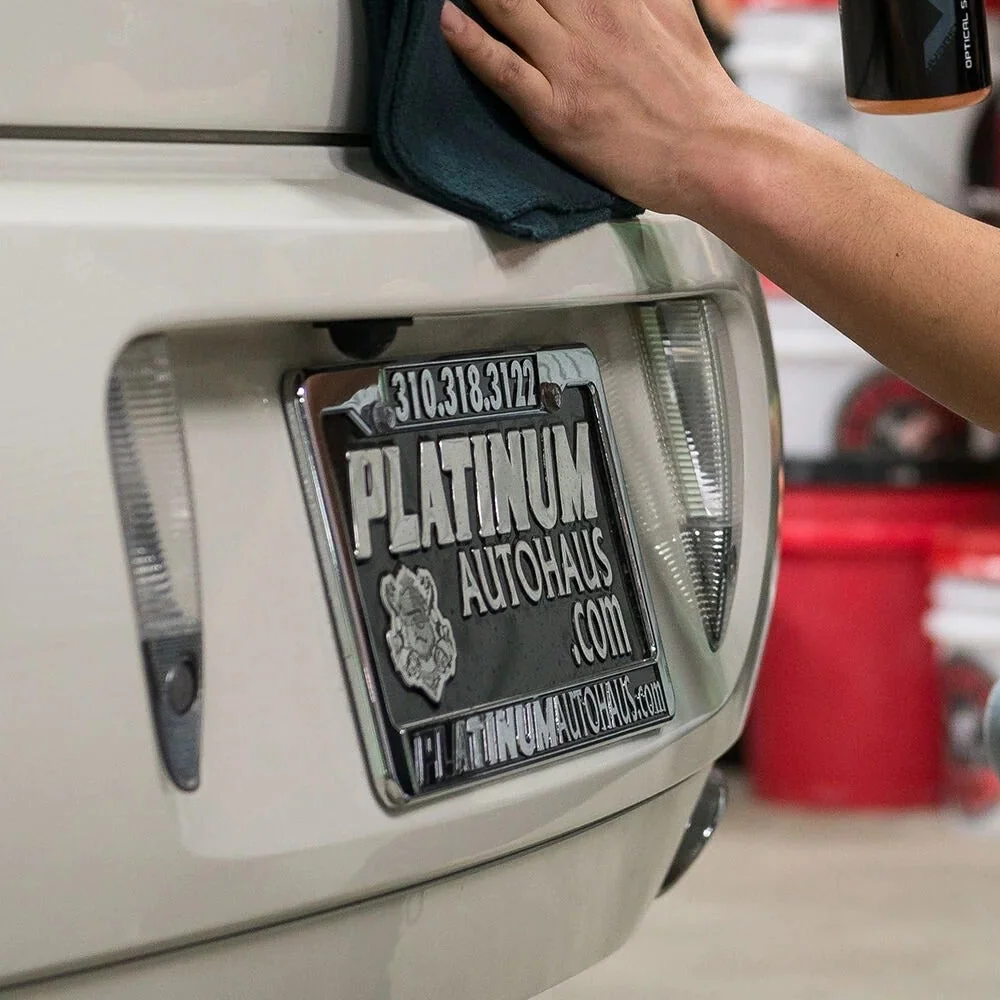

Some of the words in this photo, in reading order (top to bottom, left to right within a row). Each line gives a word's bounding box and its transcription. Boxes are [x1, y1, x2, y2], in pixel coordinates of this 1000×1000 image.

[962, 12, 973, 69] OPTICAL
[392, 358, 537, 423] 310.318.3122
[345, 421, 599, 561] PLATINUM
[458, 528, 614, 617] AUTOHAUS
[570, 593, 633, 666] .com
